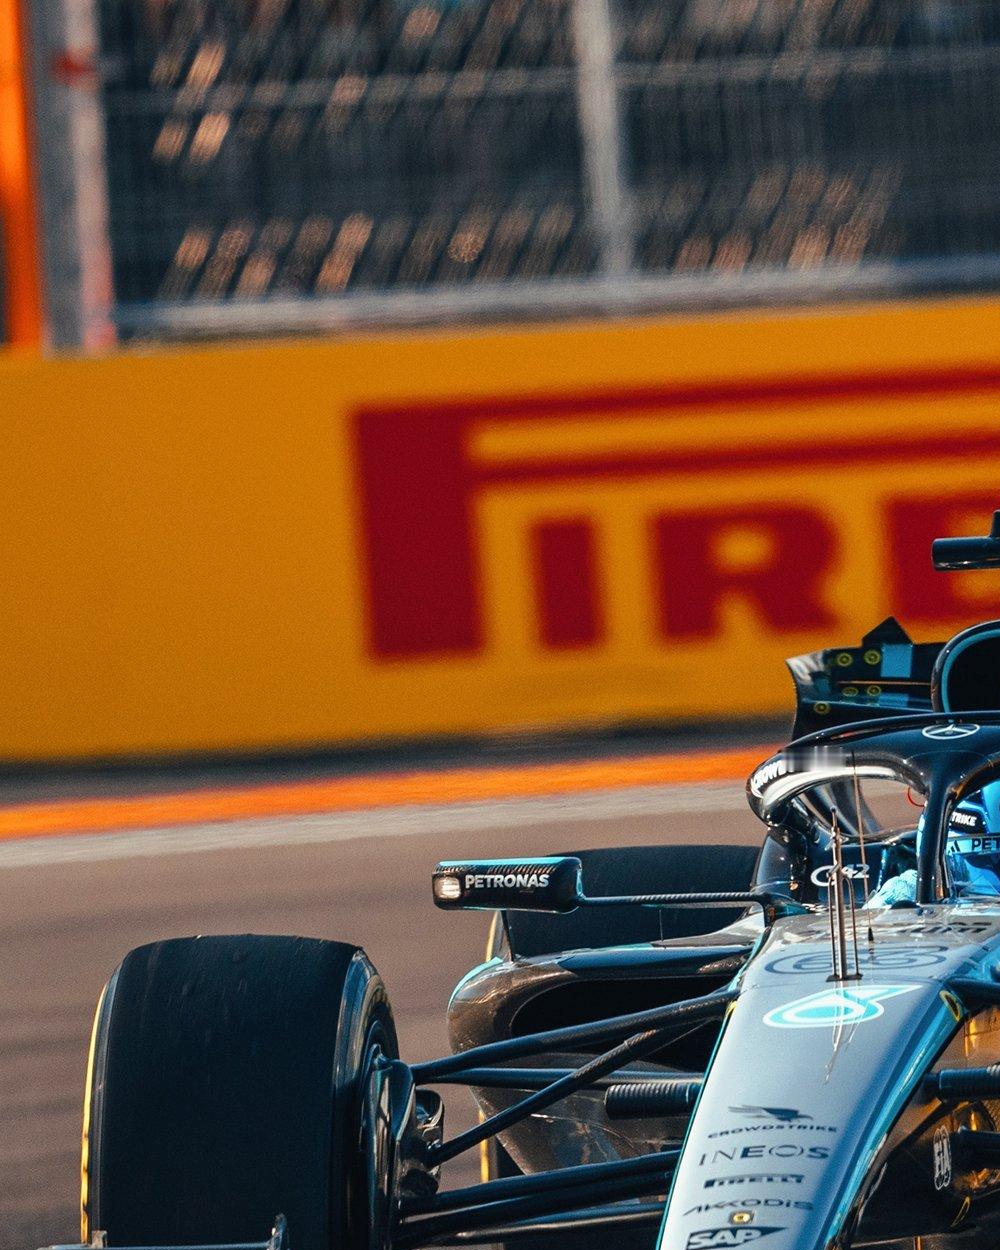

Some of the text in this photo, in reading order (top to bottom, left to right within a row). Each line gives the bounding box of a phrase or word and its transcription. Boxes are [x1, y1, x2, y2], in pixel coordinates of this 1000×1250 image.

[465, 874, 550, 889] PETRONAS
[708, 1124, 837, 1140] CROWDSTRIKE
[698, 1144, 831, 1167] INEOS
[703, 1173, 805, 1190] PIRELLI
[688, 1229, 763, 1247] SAP
